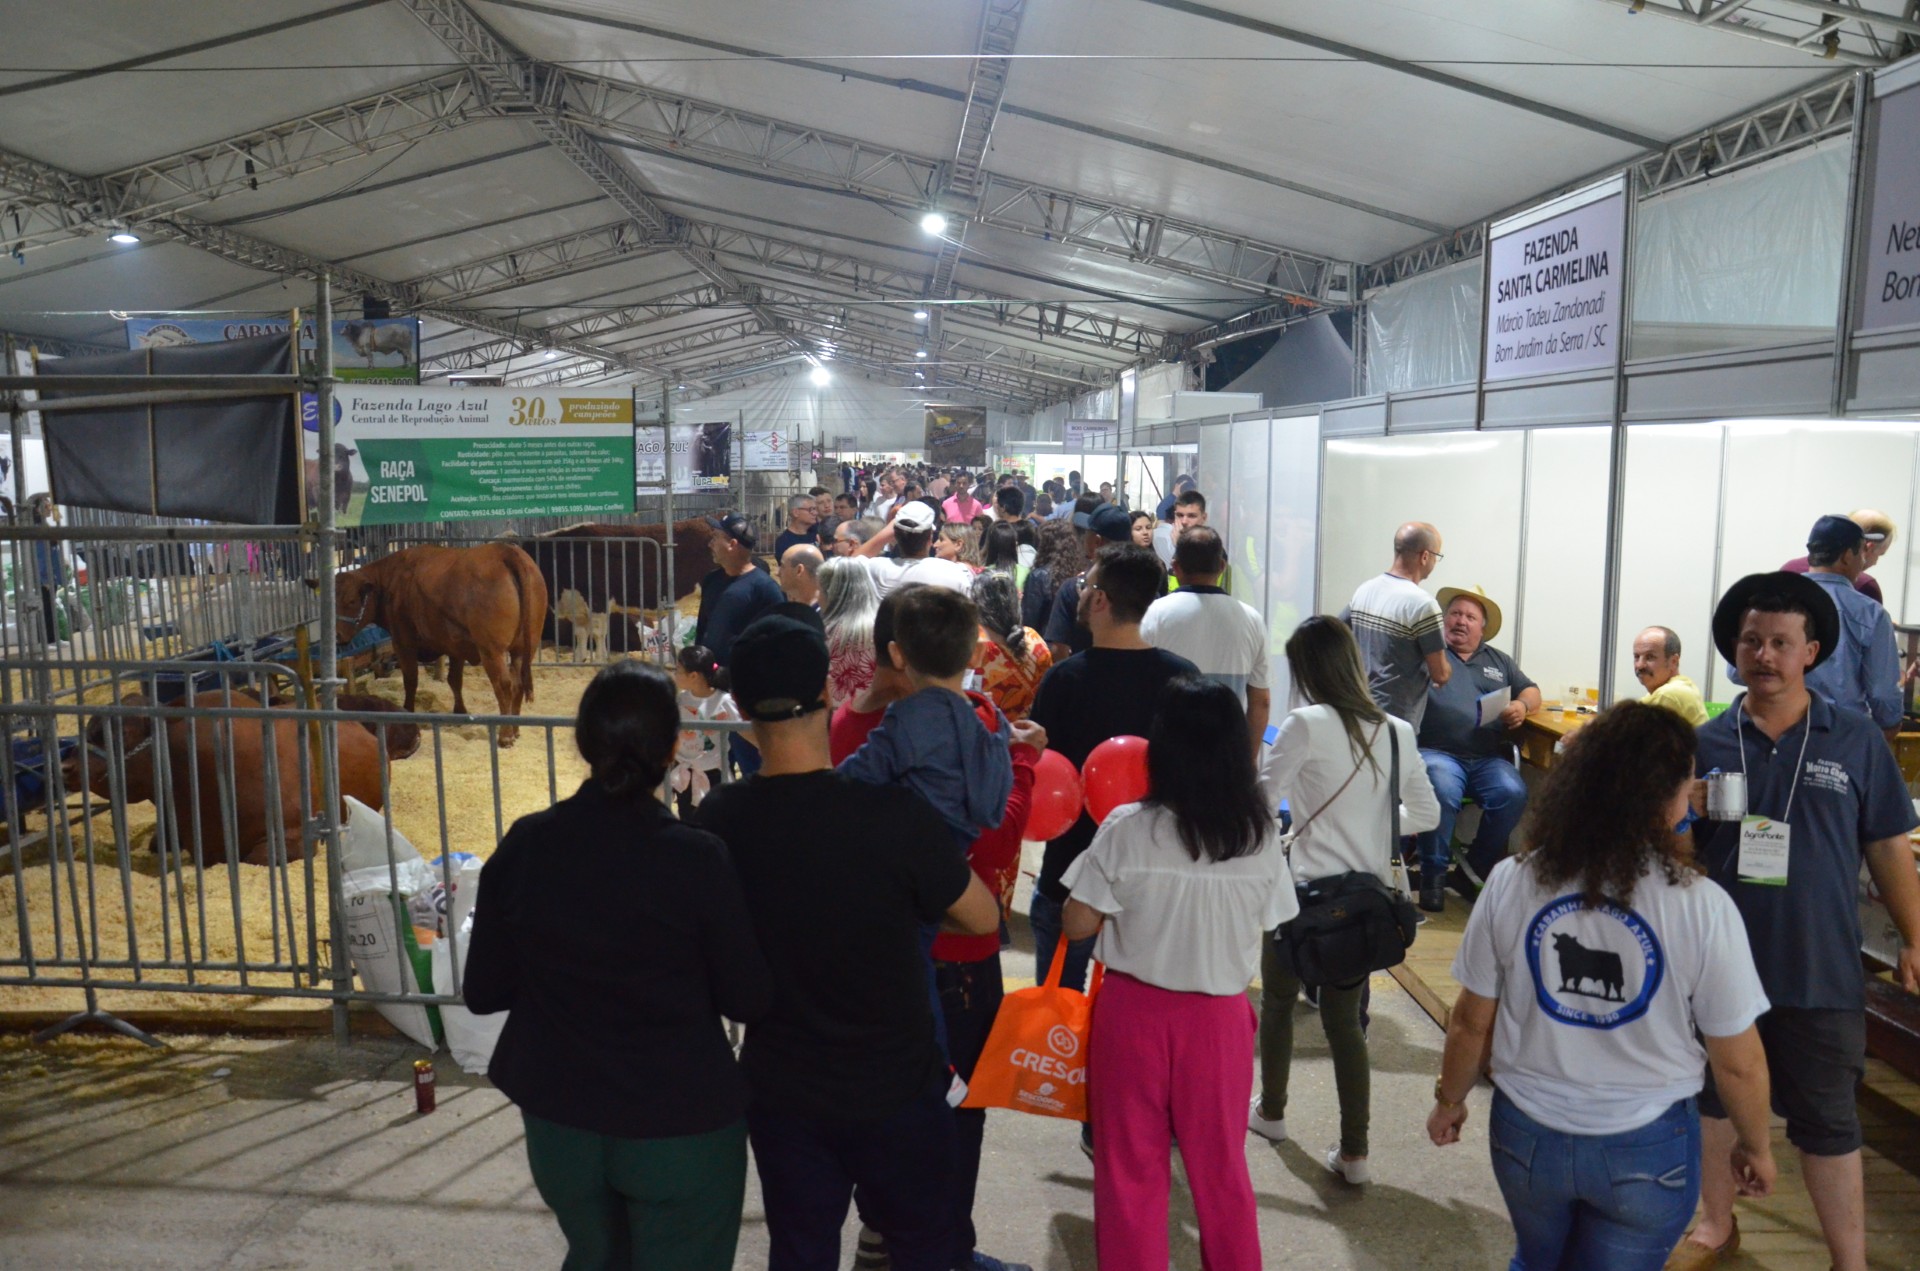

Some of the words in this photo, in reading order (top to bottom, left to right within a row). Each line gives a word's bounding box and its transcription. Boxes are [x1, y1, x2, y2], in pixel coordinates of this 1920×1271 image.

[1524, 226, 1578, 266] FAZENDA
[1497, 273, 1532, 303] SANTA
[1535, 250, 1609, 293] CARMELINA
[1496, 312, 1524, 334] Márcio
[1526, 304, 1551, 328] Tadeu
[1552, 290, 1606, 323] Zandonadi
[1495, 343, 1513, 363] Bom
[1514, 335, 1543, 360] Jardim
[1545, 333, 1558, 355] da
[1559, 331, 1584, 353] Serra
[1592, 323, 1608, 348] SC
[352, 398, 413, 411] Fazenda
[417, 398, 452, 415] Lago
[456, 398, 489, 411] Azul
[508, 396, 546, 427] 30
[568, 401, 621, 413] produzindo
[352, 414, 386, 424] Central
[388, 414, 400, 424] de
[401, 413, 455, 427] Reprodução
[458, 414, 489, 424] Animal
[524, 416, 557, 427] anos
[573, 409, 617, 421] campeões
[636, 442, 661, 453] AGO
[381, 460, 416, 481] RAÇA
[370, 484, 429, 504] SENEPOL
[440, 510, 471, 518] CONTATO:
[1806, 761, 1830, 774] Morro
[1744, 830, 1785, 841] AgroPonte
[1594, 903, 1629, 922] AGO
[1630, 923, 1655, 958] AZUL
[1556, 1005, 1588, 1021] SINCE
